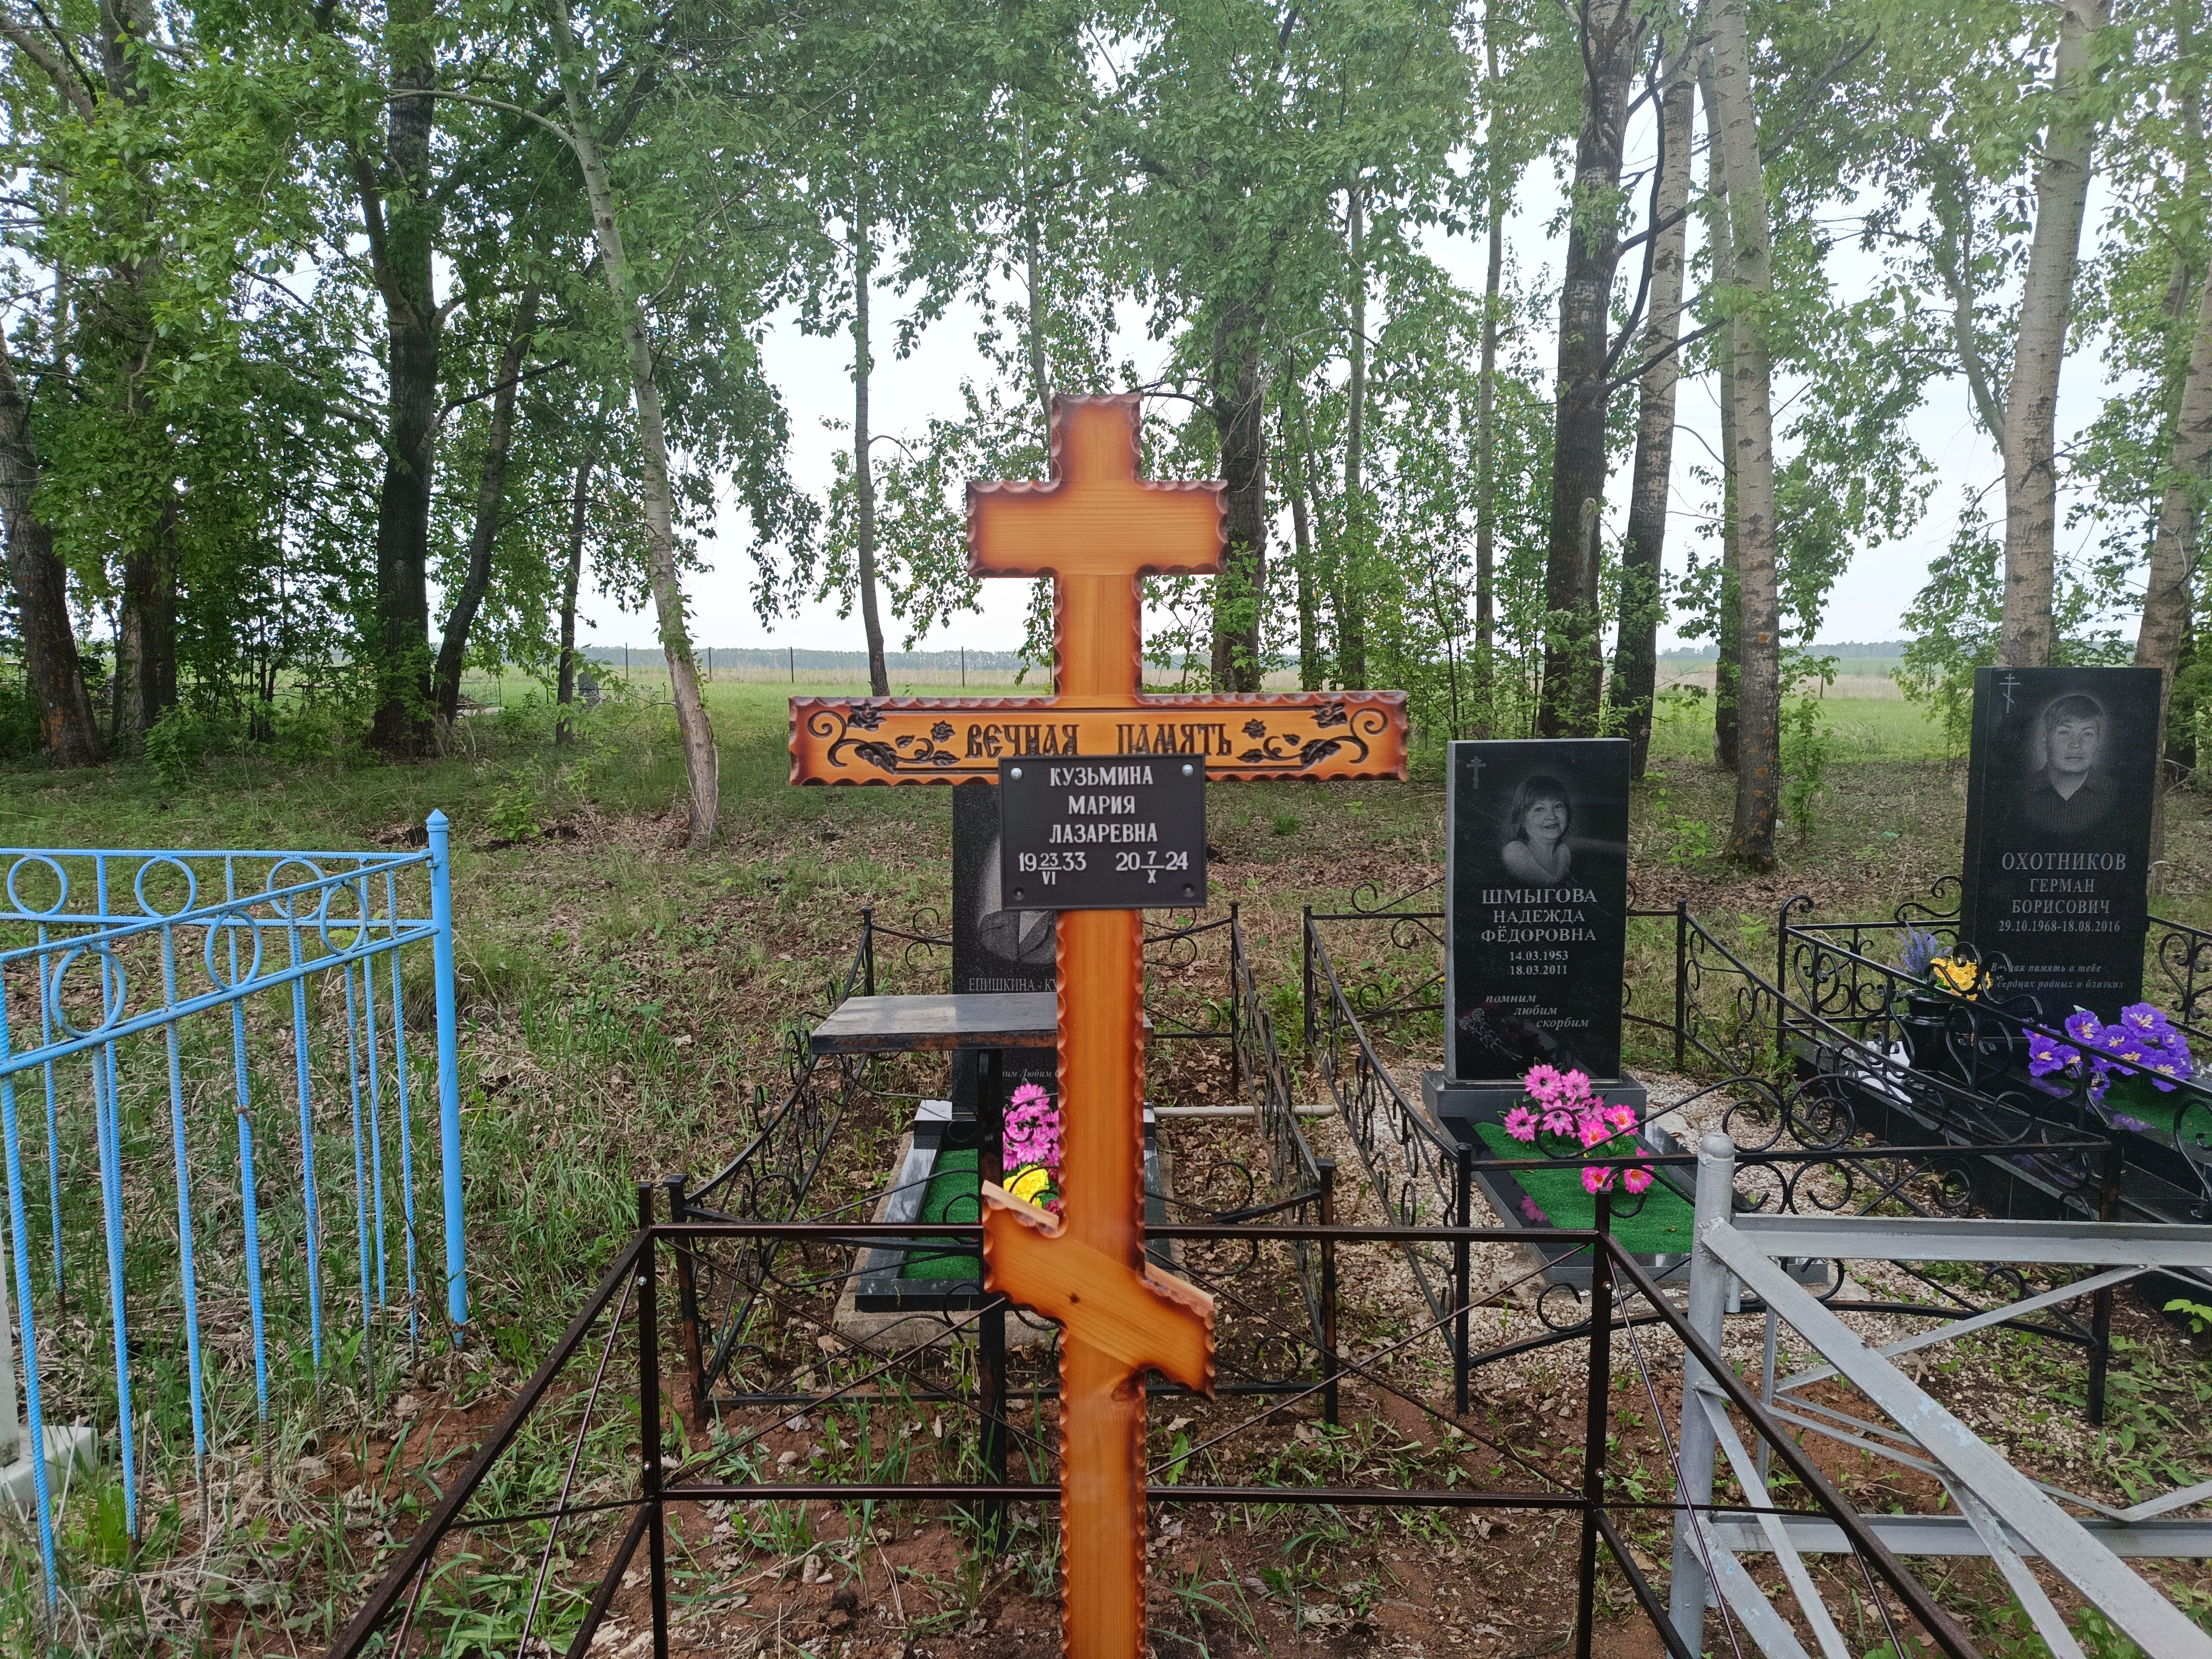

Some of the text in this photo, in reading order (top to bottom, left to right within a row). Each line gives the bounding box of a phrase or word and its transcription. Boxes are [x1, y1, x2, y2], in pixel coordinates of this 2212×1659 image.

[965, 723, 1232, 758] ВЕЧНАЯ ПАМЯТЬ
[1050, 766, 1154, 786] КУЗЬМИНА
[1068, 796, 1135, 815] МАРИЯ
[1050, 823, 1158, 843] ЛАЗАРЕВНА
[2001, 853, 2127, 870] ОХОТНИКОВ
[2030, 878, 2095, 893] ГЕРМАН
[1481, 888, 1598, 904] ШМЫГОВА
[2012, 899, 2110, 914] БОРИСОВИЧ
[1493, 910, 1585, 925] НАДЕЖДА
[1481, 926, 1597, 944] ФЁДОРОВНА
[1510, 951, 1568, 961] 14.03.1953
[1510, 965, 1567, 975] 18.03.2011
[2078, 963, 2101, 972] тебе
[969, 978, 1035, 991] ЕПИШКИНА
[2038, 979, 2073, 990] родных
[2085, 979, 2125, 988] близких
[1514, 1005, 1557, 1015] любим
[1536, 1018, 1589, 1030] скорбим
[1020, 1068, 1052, 1077] Любим
